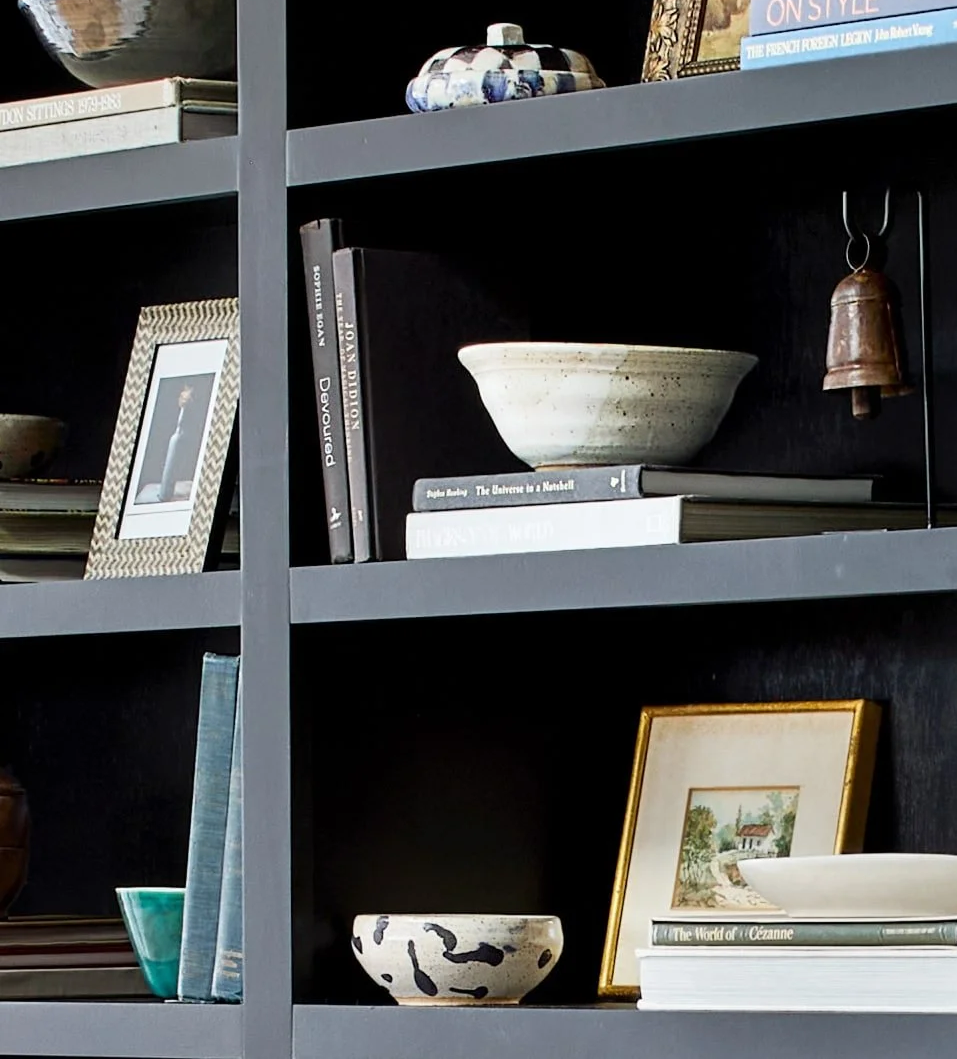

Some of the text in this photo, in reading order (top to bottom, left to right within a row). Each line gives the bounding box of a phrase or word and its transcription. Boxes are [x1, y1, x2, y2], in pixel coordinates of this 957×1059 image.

[746, 44, 765, 59] THE
[766, 39, 800, 58] FRENCH
[802, 35, 839, 53] FOREIGN
[840, 29, 873, 47] LEGION
[0, 92, 122, 126] DON SITTINGS 1979-1983
[311, 264, 337, 468] SOPHIE EGAN Devoured
[345, 321, 361, 431] JOAN DIDION
[475, 484, 490, 496] The
[492, 483, 524, 496] Universe
[535, 483, 541, 493] a
[542, 479, 574, 493] Nutshell
[673, 924, 795, 942] The World of Cézanne
